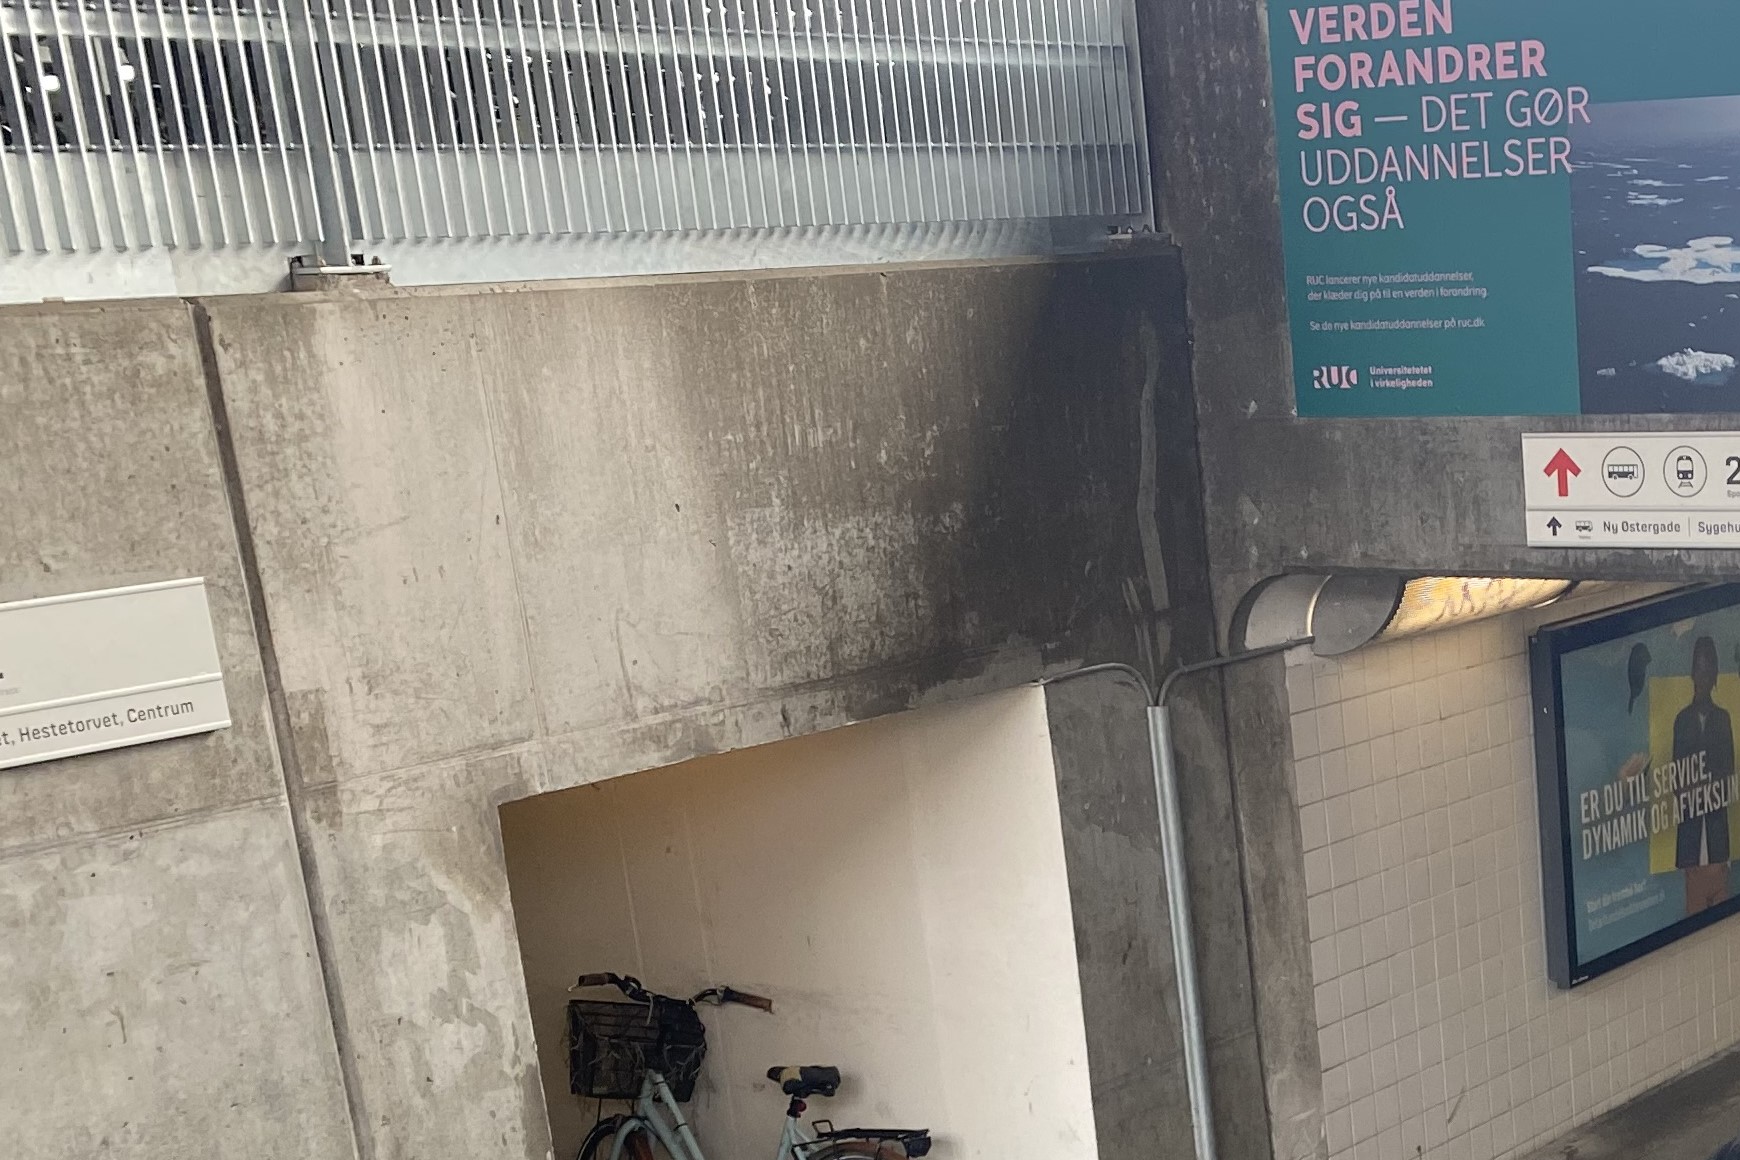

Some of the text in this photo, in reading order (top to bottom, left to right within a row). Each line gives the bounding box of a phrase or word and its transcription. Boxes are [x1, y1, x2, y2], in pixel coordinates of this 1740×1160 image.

[1289, 0, 1453, 45] VERDEN
[1294, 39, 1548, 93] FORANDRER
[1296, 100, 1362, 140] SIG
[1421, 91, 1494, 133] DET
[1505, 86, 1591, 128] GØR
[1300, 136, 1573, 187] UDDANNELSER
[1302, 185, 1405, 233] OGSÅ
[1306, 275, 1325, 285] RUC
[1325, 274, 1361, 285] lancerer
[1362, 276, 1377, 288] nye
[1307, 290, 1321, 301] der
[1354, 289, 1368, 302] dig
[1369, 288, 1381, 301] på
[1383, 288, 1391, 299] til
[1392, 290, 1403, 299] en
[1404, 287, 1435, 299] verden
[1309, 320, 1321, 331] Se
[1322, 320, 1333, 331] de
[1333, 321, 1350, 333] nye
[1350, 318, 1442, 330] kandidatuddannelser
[1444, 317, 1456, 330] på
[1312, 365, 1358, 389] RUC
[1375, 378, 1433, 390] virkeligheden
[1603, 520, 1681, 535] Ny Østergade
[19, 712, 124, 742] Hestetorvet,
[127, 701, 194, 723] Centrum
[1580, 750, 1712, 824] ER DU TIL SERVICE,
[1582, 806, 1648, 860] DYNAMIK
[1651, 801, 1669, 835] OG
